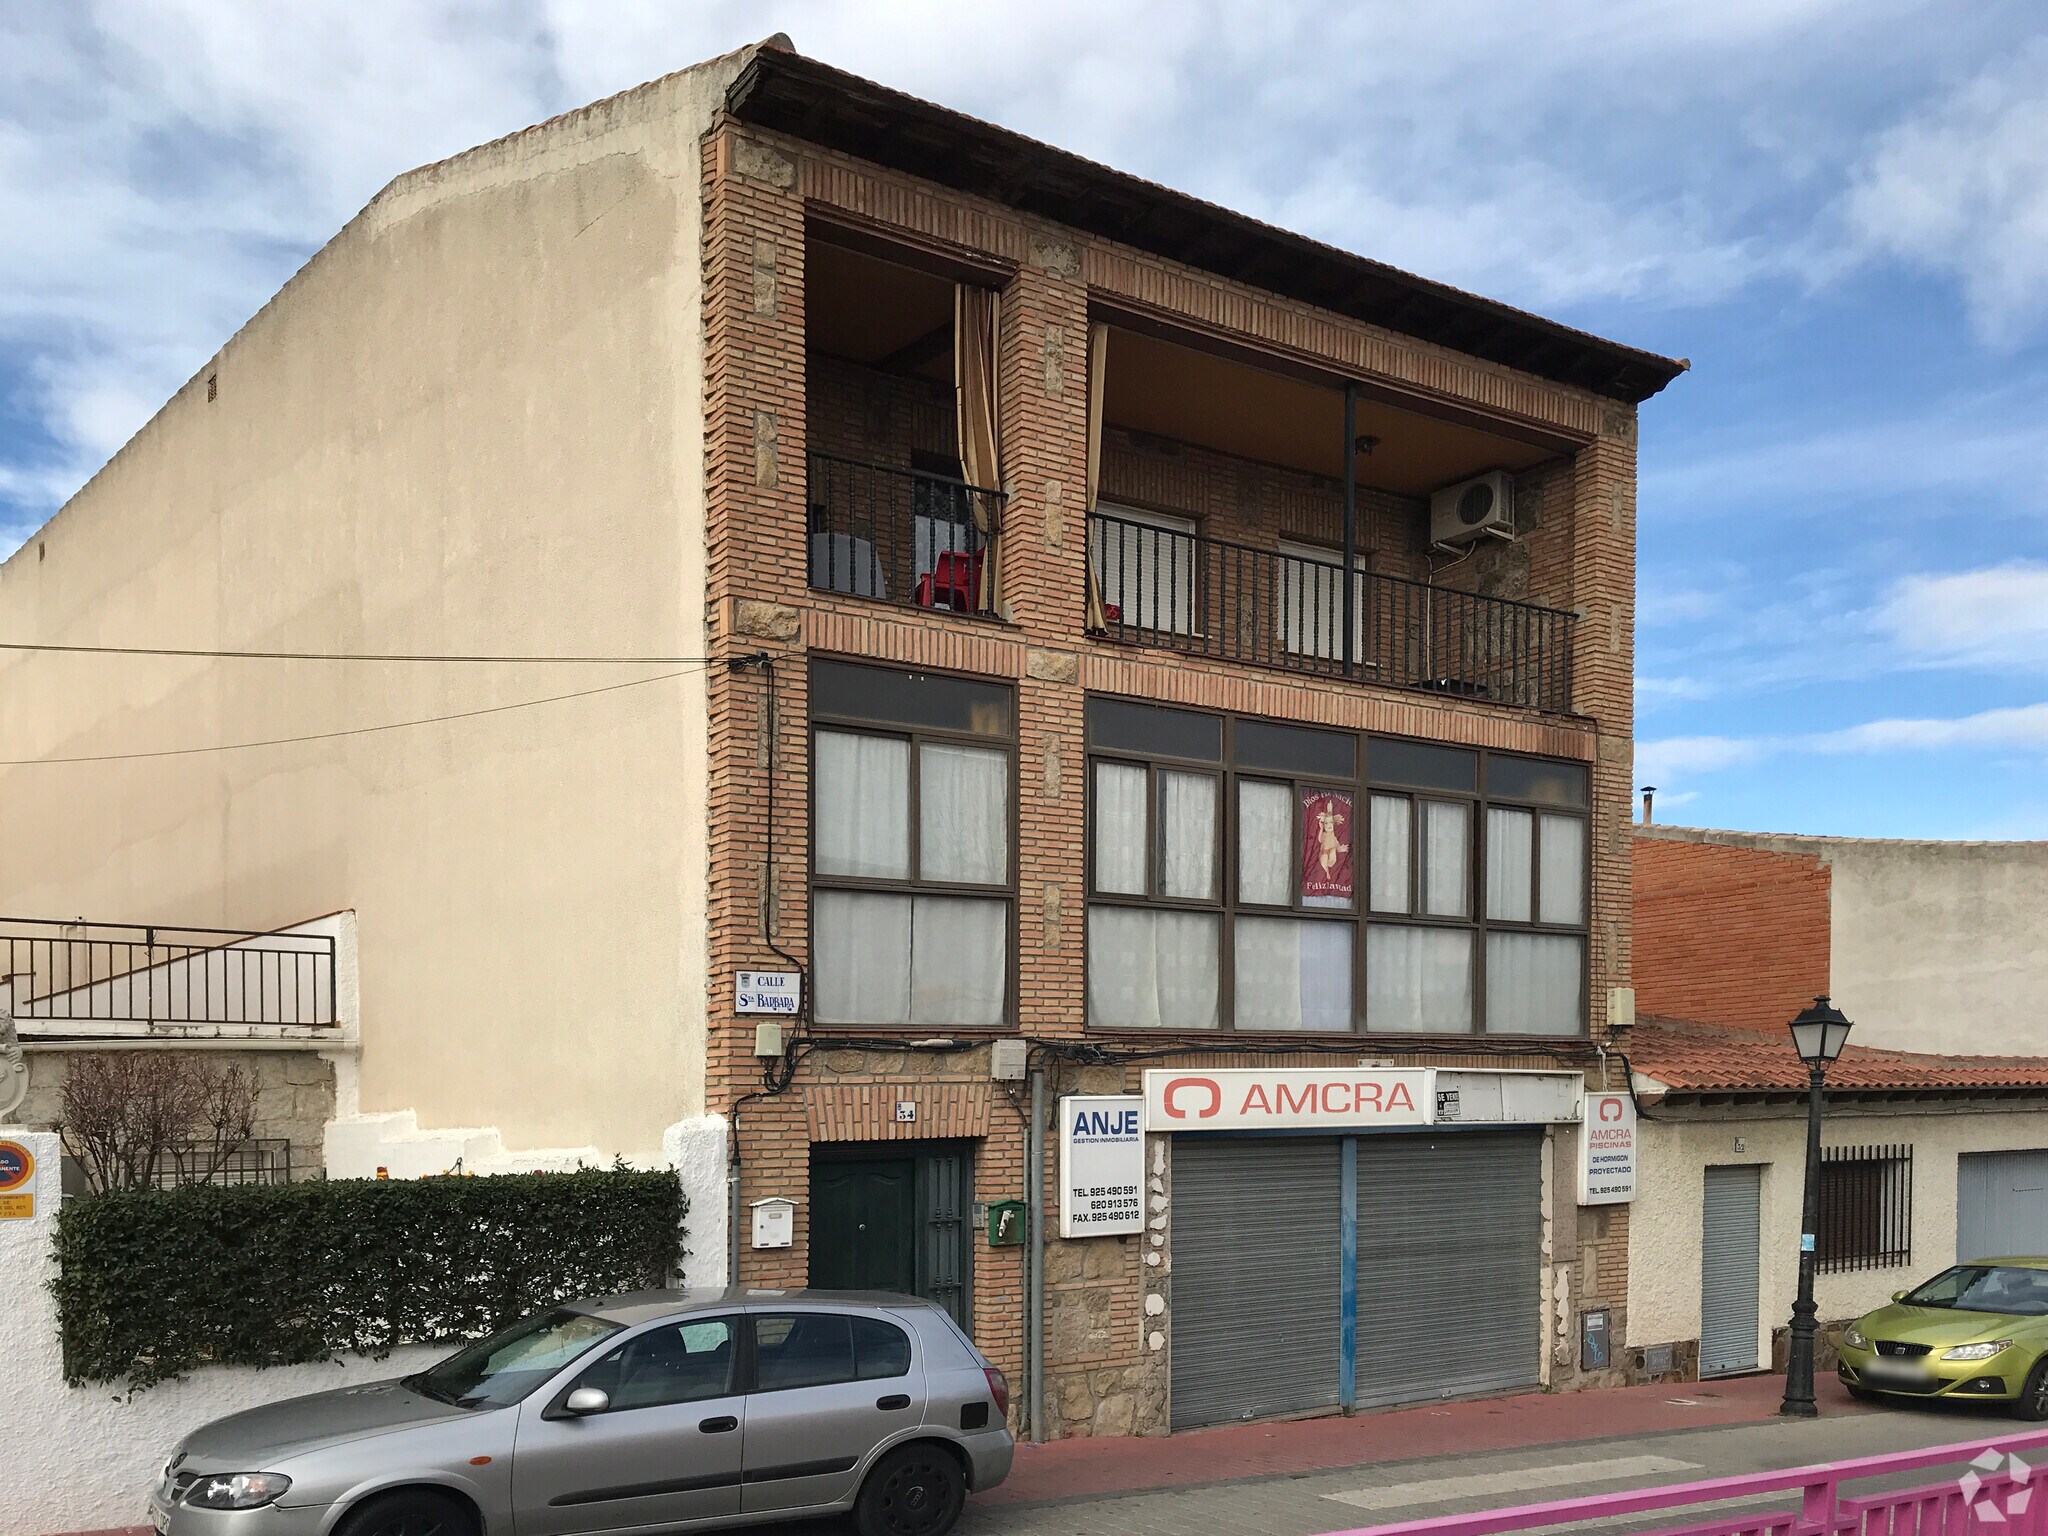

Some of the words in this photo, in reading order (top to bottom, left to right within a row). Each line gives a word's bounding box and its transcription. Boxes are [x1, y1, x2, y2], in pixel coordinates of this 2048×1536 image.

[1303, 794, 1319, 808] Dios
[1306, 881, 1327, 890] Feliz
[757, 976, 785, 987] CALLE
[1240, 1082, 1415, 1115] AMCRA
[1437, 1093, 1446, 1102] SE
[899, 1110, 914, 1120] 34
[1073, 1111, 1138, 1136] ANJE
[1590, 1129, 1632, 1140] AMCRA
[1589, 1141, 1632, 1149] PISCINAS
[1600, 1154, 1629, 1163] HORMIGON
[1589, 1166, 1632, 1175] PROYECTADO
[1090, 1187, 1106, 1196] 925
[1106, 1186, 1122, 1195] 490
[1123, 1185, 1138, 1194] 591
[1091, 1200, 1107, 1209] 620
[1107, 1199, 1122, 1208] 913
[1123, 1198, 1138, 1207] 576
[1072, 1213, 1091, 1223] FAX.
[1091, 1212, 1107, 1222] 925
[1108, 1211, 1123, 1220] 490
[1124, 1210, 1139, 1219] 612
